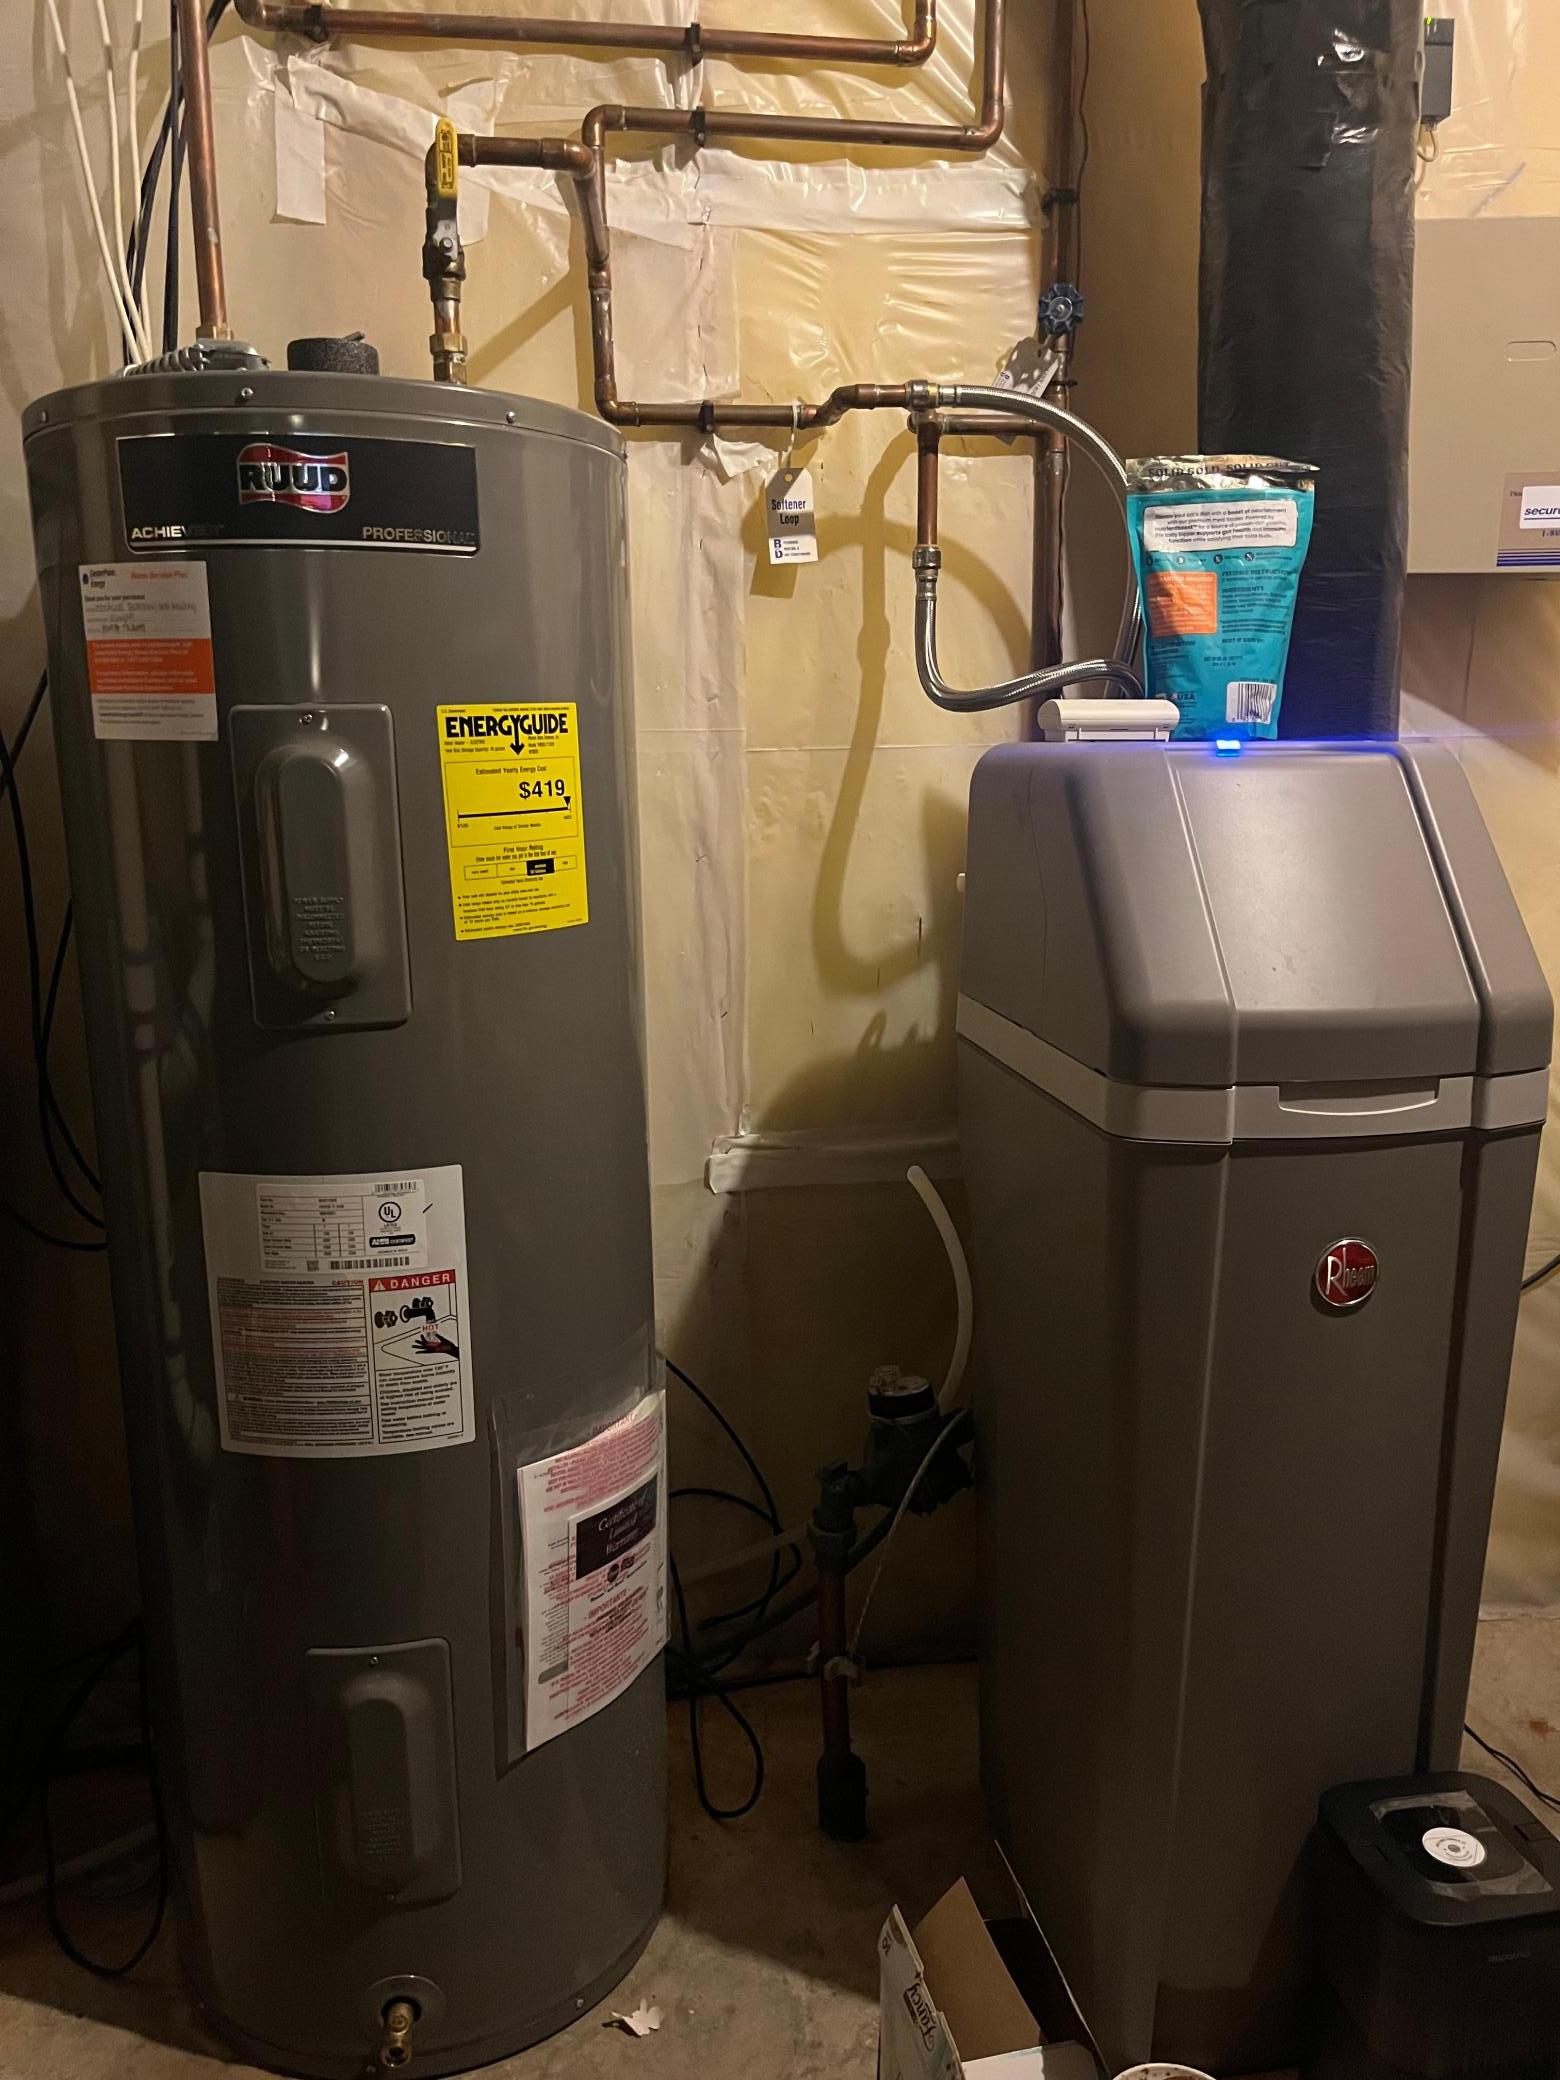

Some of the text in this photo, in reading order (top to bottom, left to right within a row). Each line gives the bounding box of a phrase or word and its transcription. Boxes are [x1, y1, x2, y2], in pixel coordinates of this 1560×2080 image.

[240, 464, 348, 492] RUUD
[771, 498, 806, 511] Softener
[779, 513, 800, 526] Loop
[445, 713, 569, 738] ENERGYGUIDE
[519, 779, 565, 800] $419
[390, 1273, 450, 1288] DANGER
[422, 1323, 439, 1333] HOT
